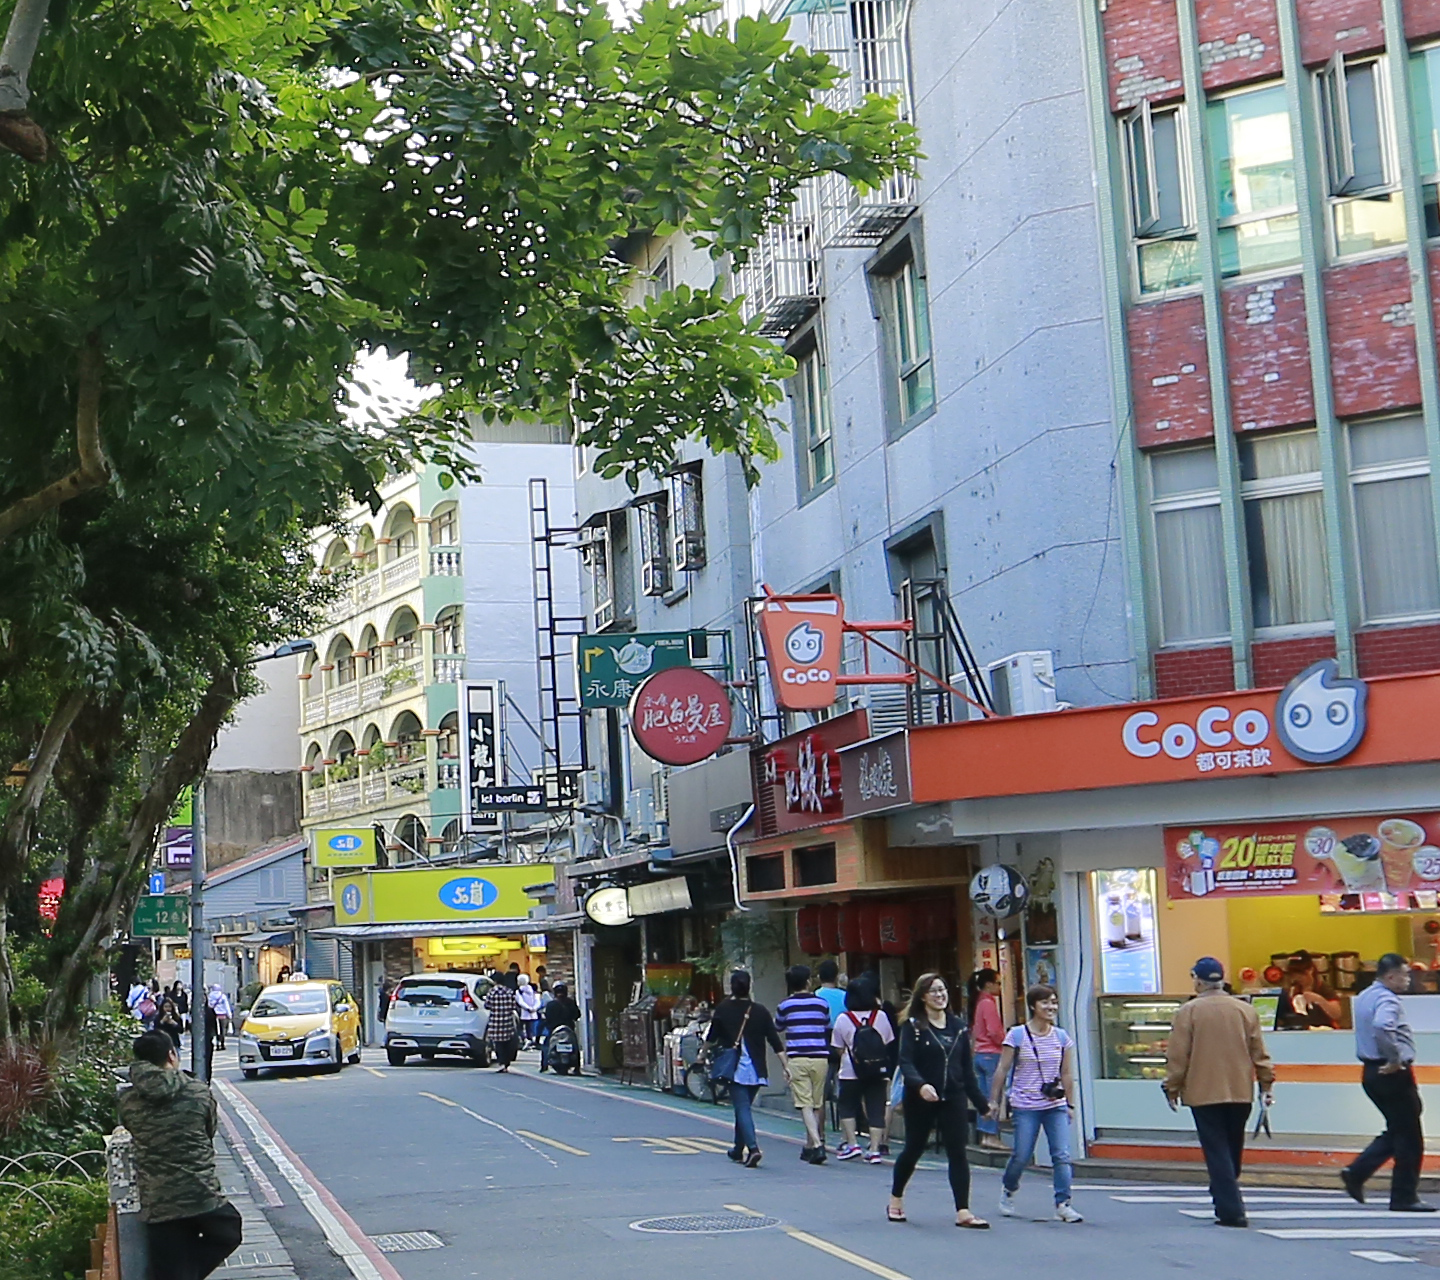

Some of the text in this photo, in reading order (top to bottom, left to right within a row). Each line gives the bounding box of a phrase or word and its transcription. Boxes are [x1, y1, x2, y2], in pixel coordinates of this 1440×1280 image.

[782, 667, 831, 685] CoCo
[586, 678, 643, 698] 永康
[641, 693, 725, 735] 肥鰻屋
[1121, 705, 1270, 759] CoCo
[1195, 747, 1273, 772] 都可茶飲
[495, 793, 525, 804] berlin
[1220, 836, 1256, 868] 20
[1312, 837, 1335, 855] 30
[155, 911, 169, 924] 12
